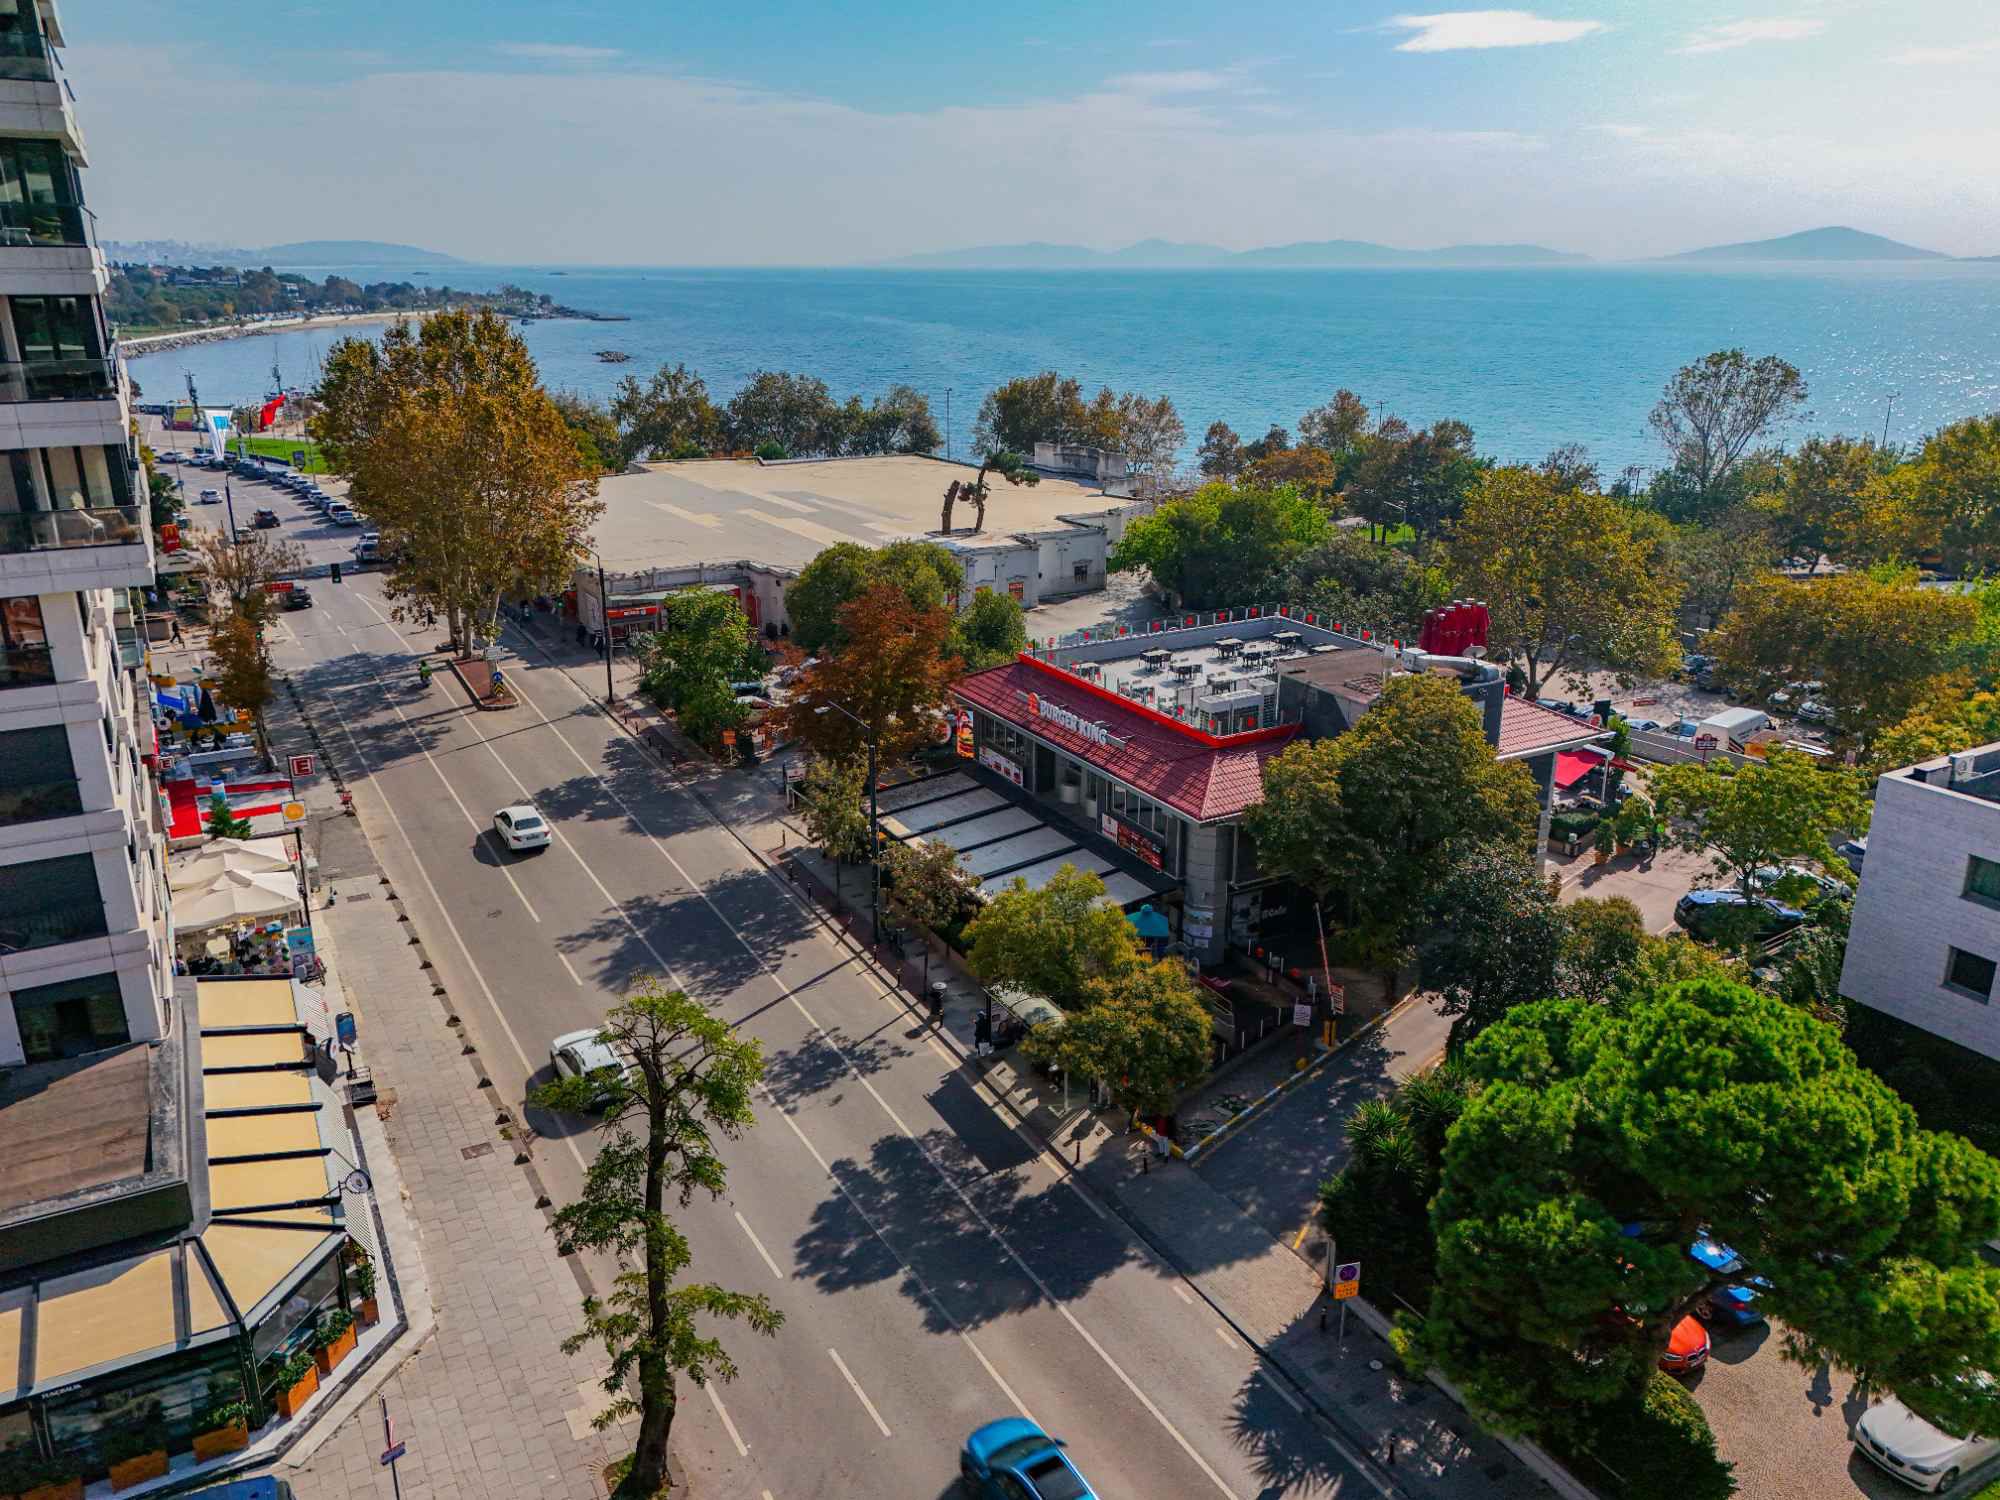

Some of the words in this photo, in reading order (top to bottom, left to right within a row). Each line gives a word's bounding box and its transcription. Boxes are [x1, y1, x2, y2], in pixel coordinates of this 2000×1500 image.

[1039, 700, 1078, 732] BURGER
[1079, 719, 1107, 745] KING
[295, 759, 309, 774] E
